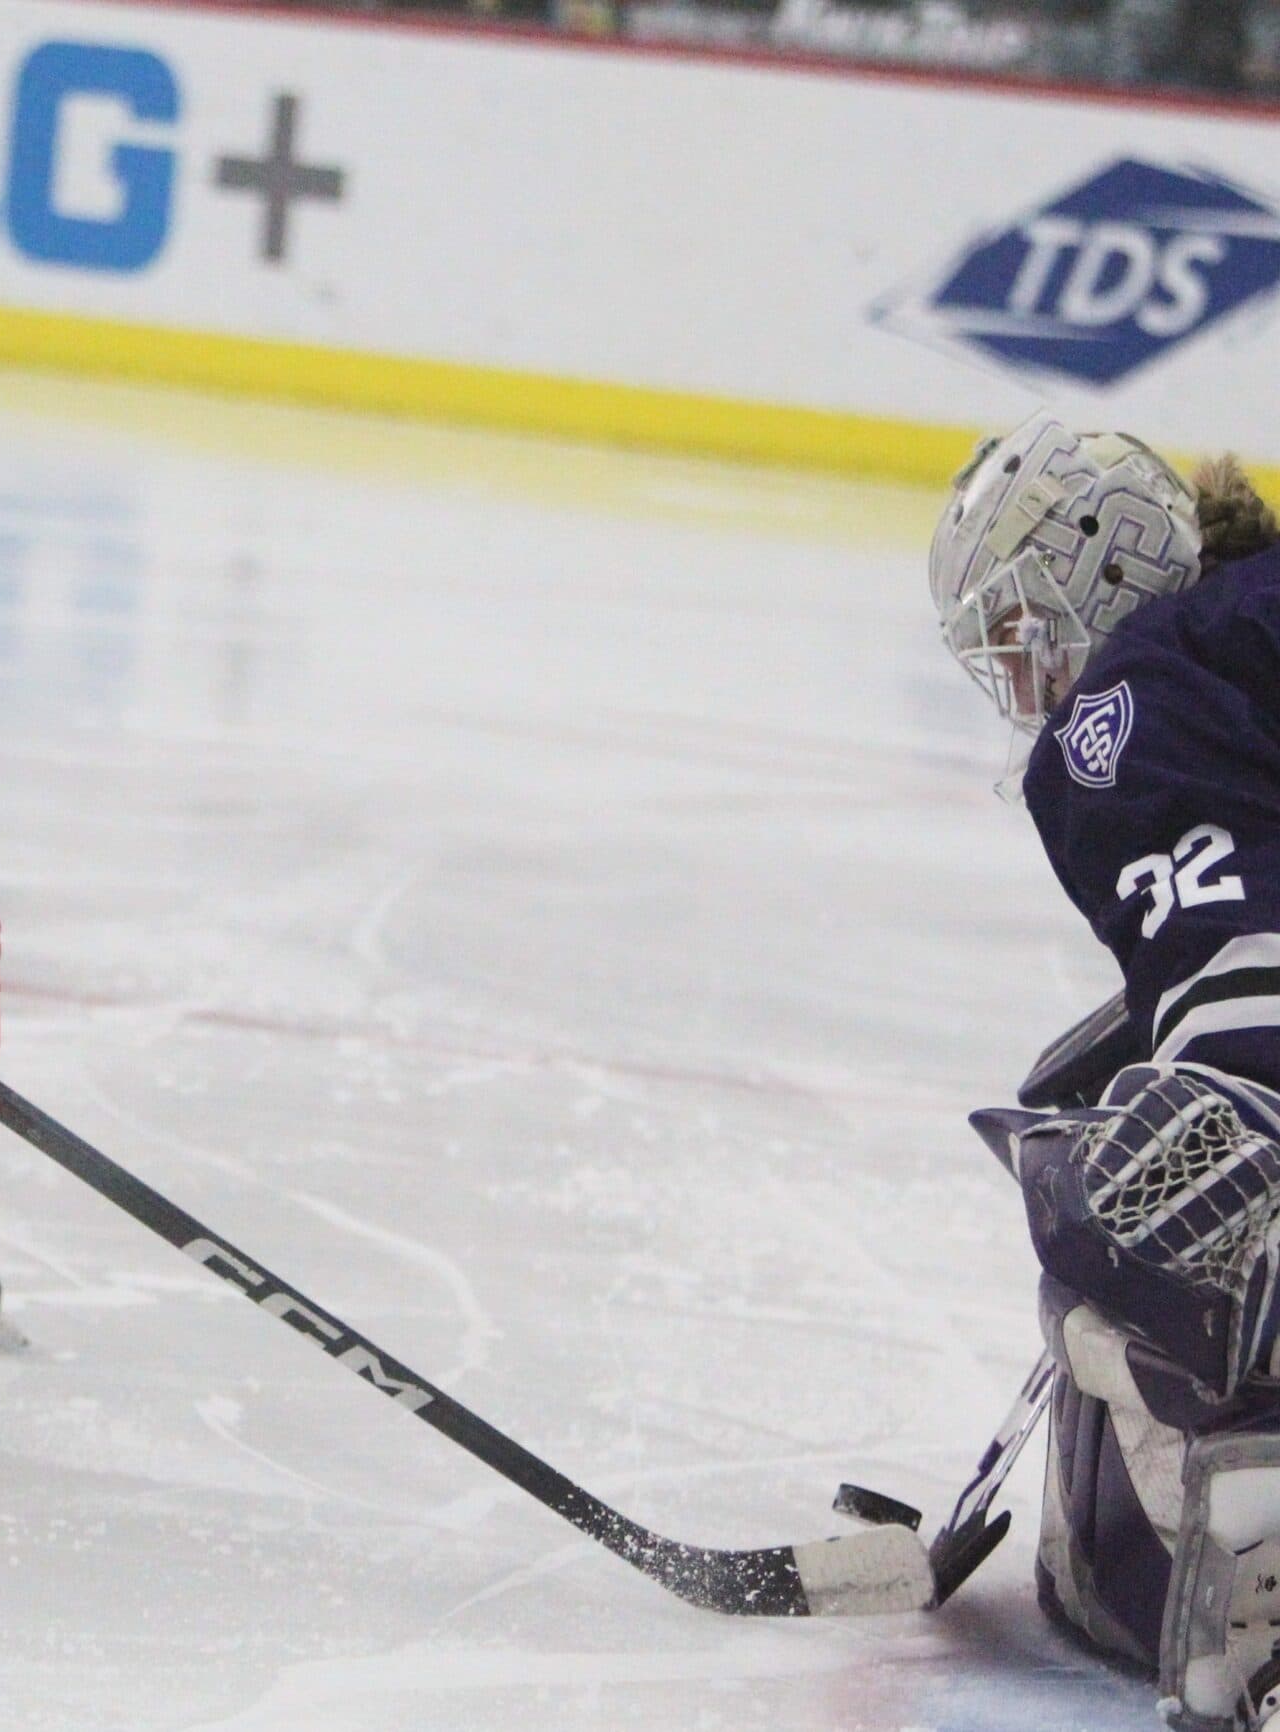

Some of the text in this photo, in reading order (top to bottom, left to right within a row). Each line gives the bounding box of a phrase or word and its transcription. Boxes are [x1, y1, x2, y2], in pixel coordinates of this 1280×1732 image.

[1008, 216, 1226, 338] TDS
[1115, 822, 1247, 941] 32
[179, 1237, 435, 1413] CCM
